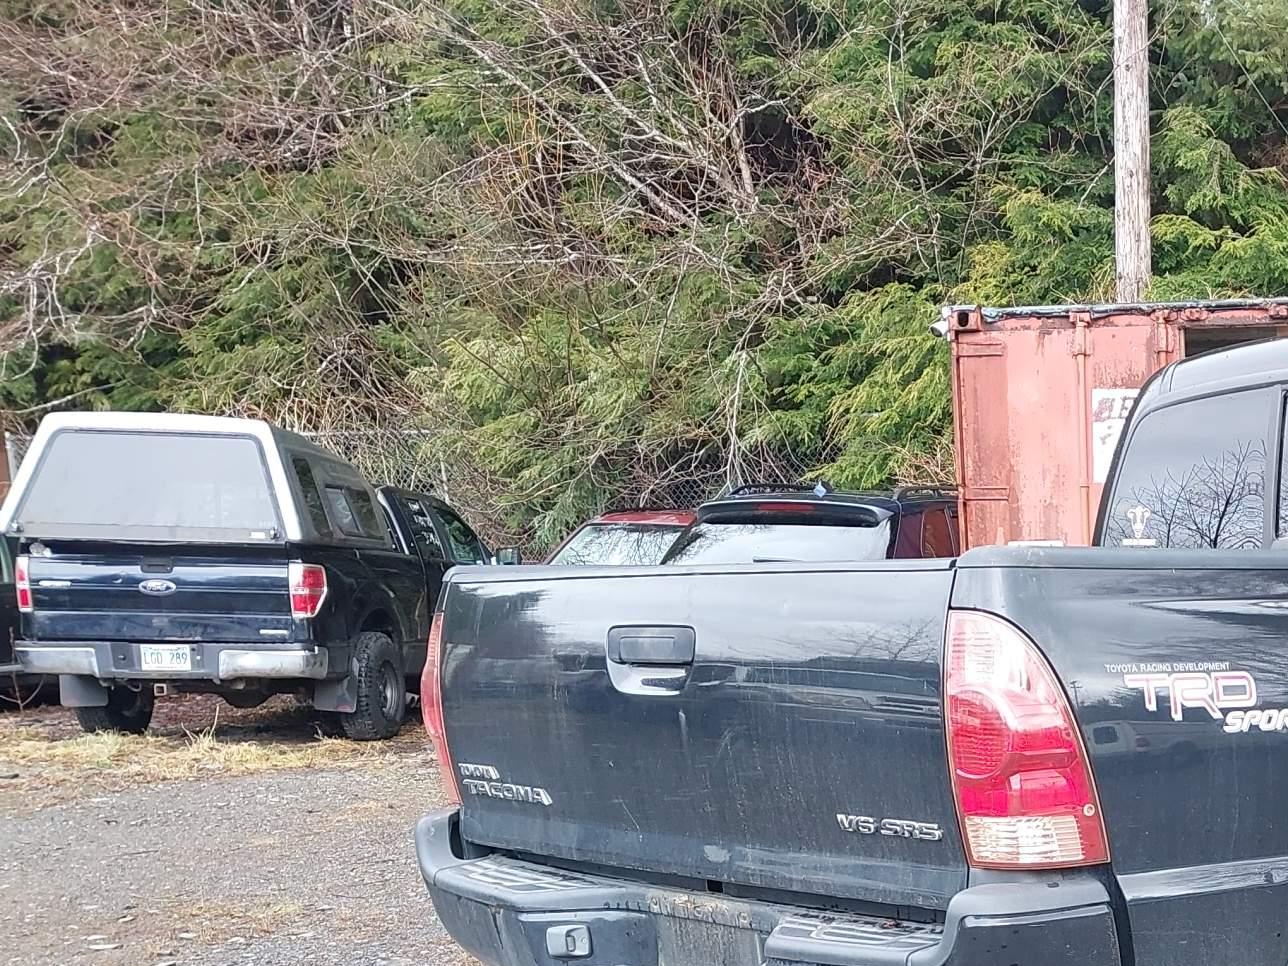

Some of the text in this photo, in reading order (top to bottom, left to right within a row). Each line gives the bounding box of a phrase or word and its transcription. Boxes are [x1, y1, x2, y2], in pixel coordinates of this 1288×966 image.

[169, 652, 188, 665] 289
[1104, 662, 1231, 673] TOYOTA RACING DEVELOPMENT
[1123, 671, 1257, 721] TRD
[462, 779, 553, 806] TACOMA
[836, 813, 944, 841] V6 SR5
